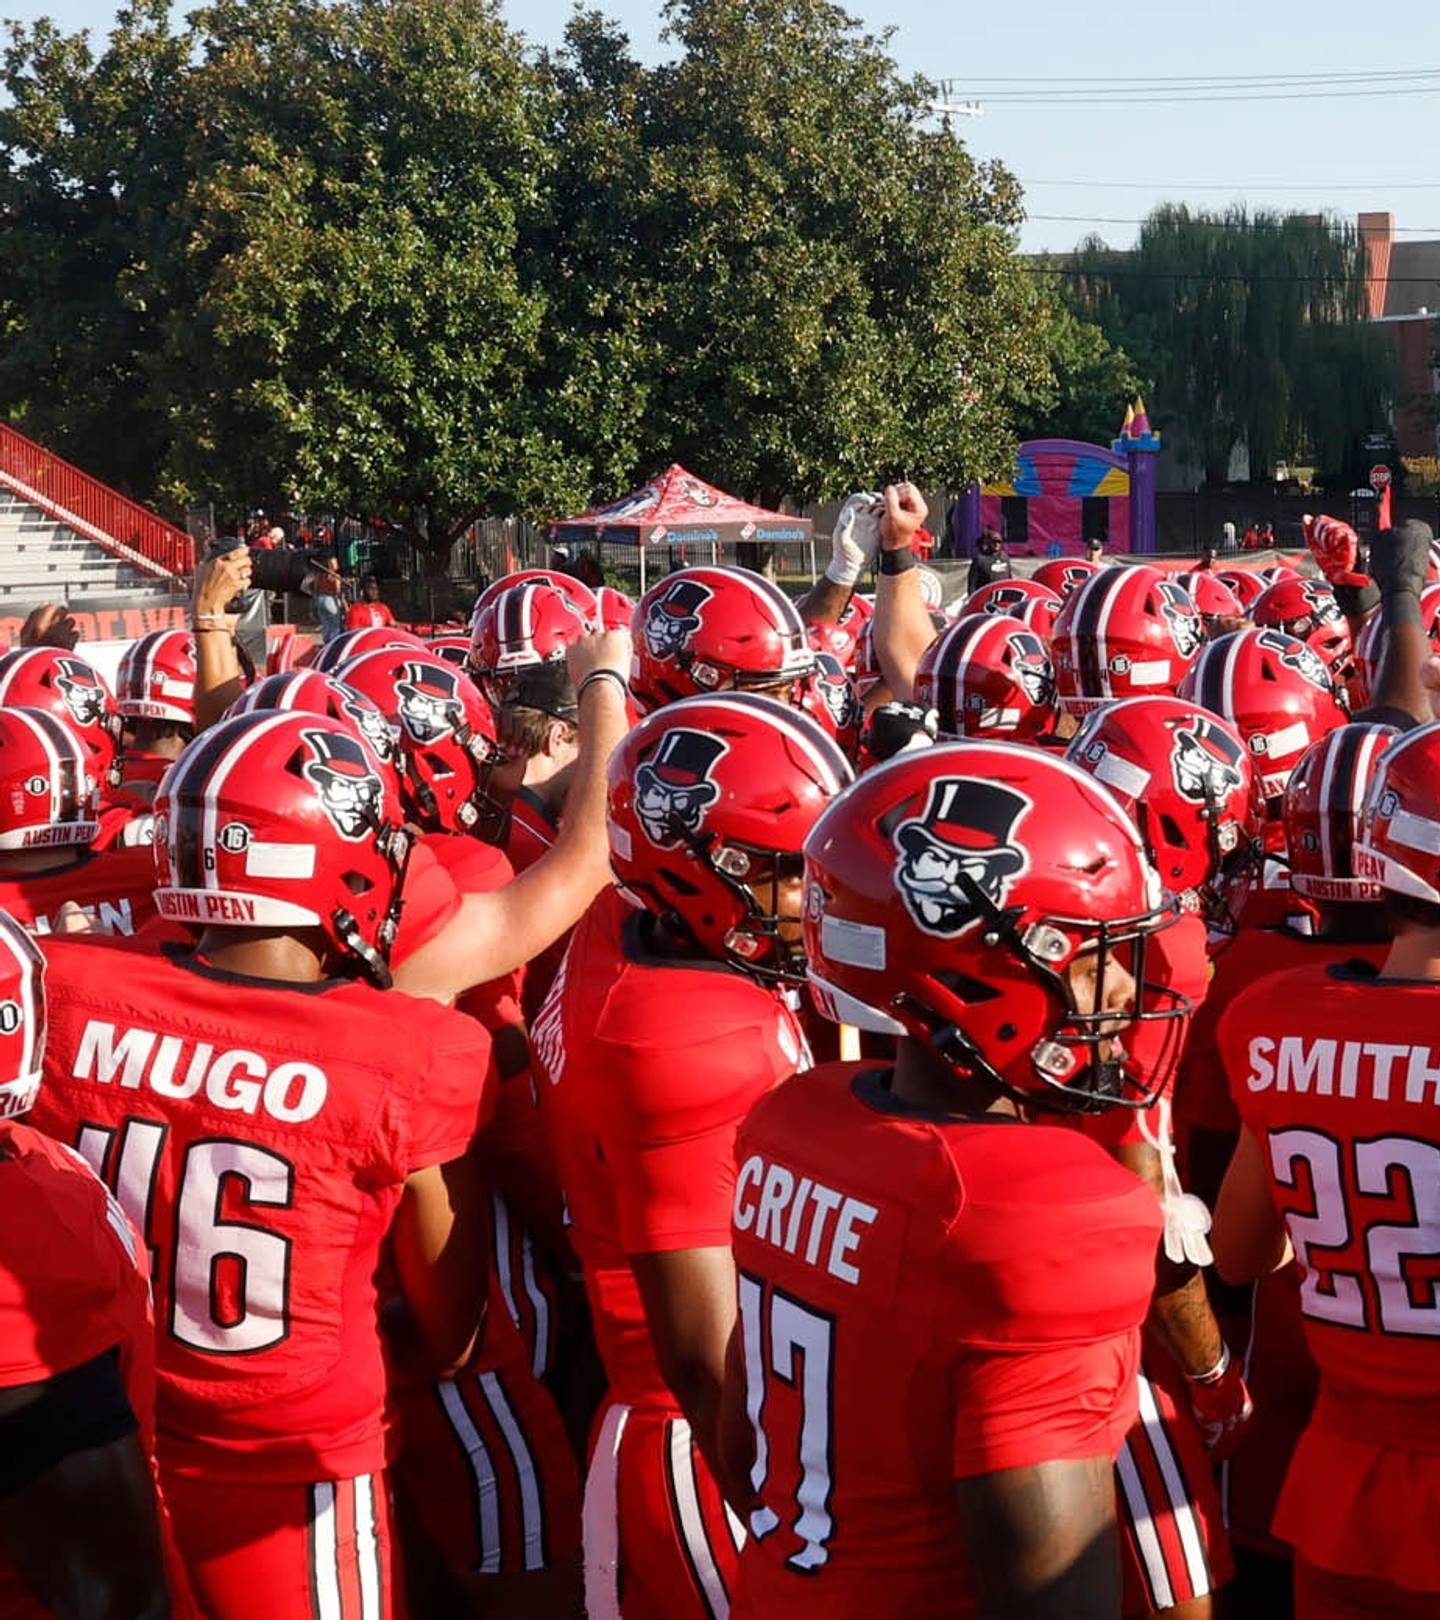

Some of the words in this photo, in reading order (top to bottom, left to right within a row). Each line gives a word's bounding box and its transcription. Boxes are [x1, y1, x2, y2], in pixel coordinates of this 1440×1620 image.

[22, 828, 71, 848] AUSTIN
[227, 827, 244, 846] 16
[204, 848, 214, 870] 6
[204, 896, 256, 921] PEAY
[73, 1020, 328, 1123] MUGO
[733, 1155, 877, 1285] CRITE
[78, 1114, 290, 1355] 46
